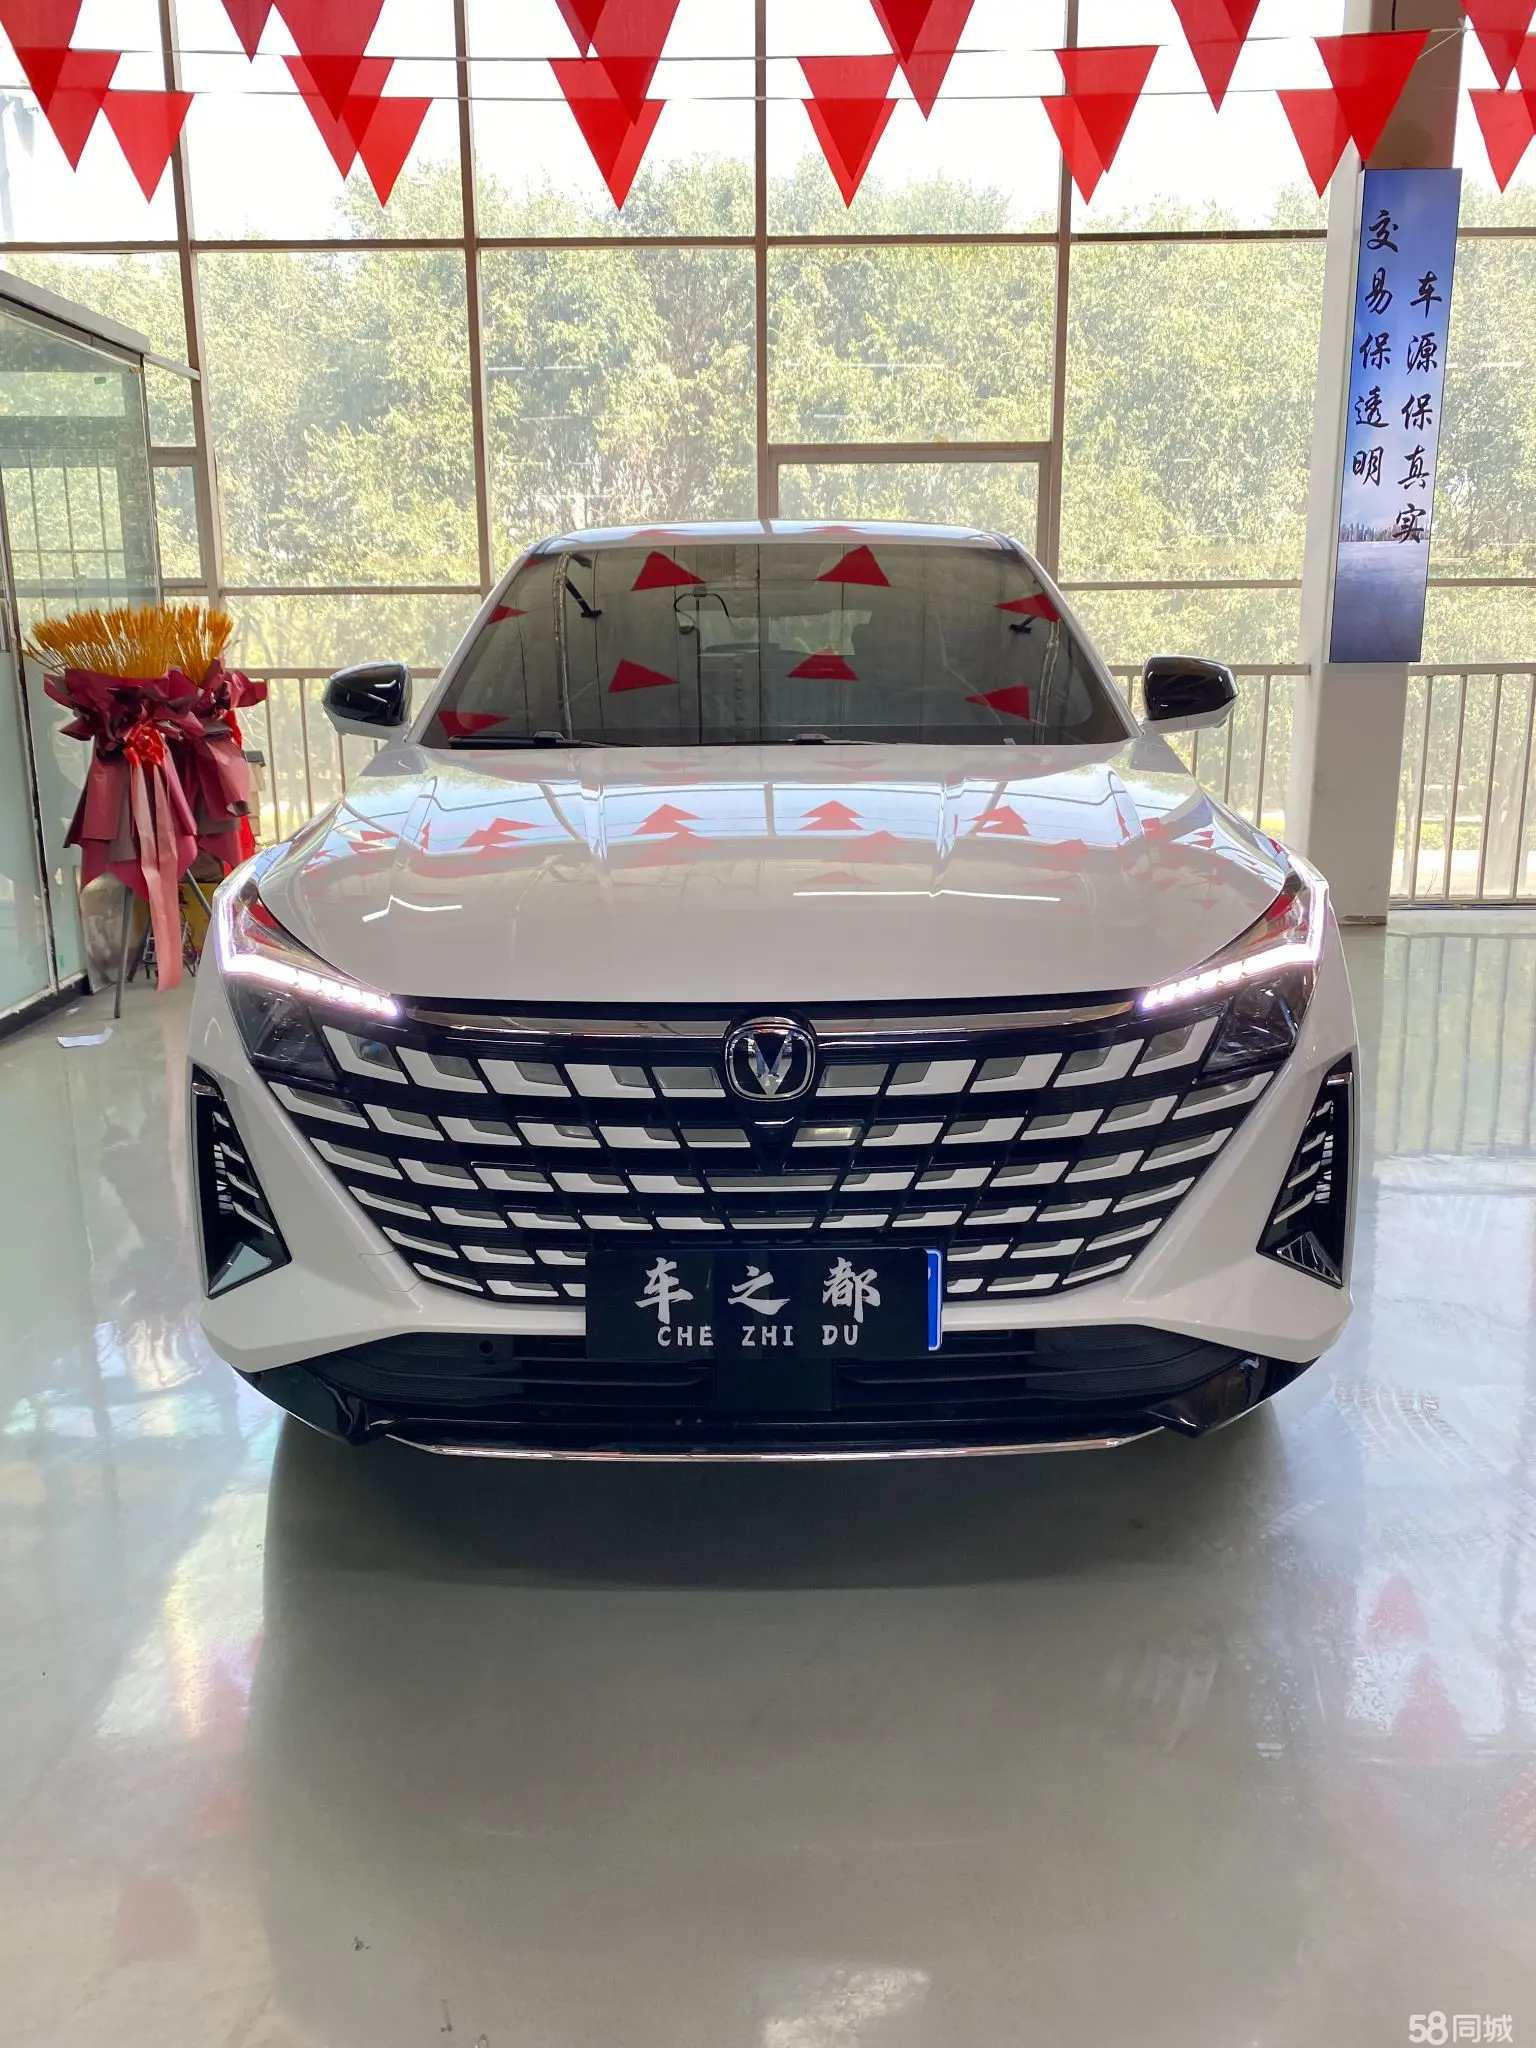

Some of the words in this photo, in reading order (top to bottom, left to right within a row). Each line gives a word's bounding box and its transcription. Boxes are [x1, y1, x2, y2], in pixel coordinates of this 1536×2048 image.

[1351, 208, 1399, 487] 交易保透明
[1394, 270, 1442, 545] 车源保真实
[634, 1256, 881, 1324] 车之都
[657, 1324, 714, 1348] CHE
[741, 1324, 794, 1347] ZHI
[822, 1324, 859, 1346] DU
